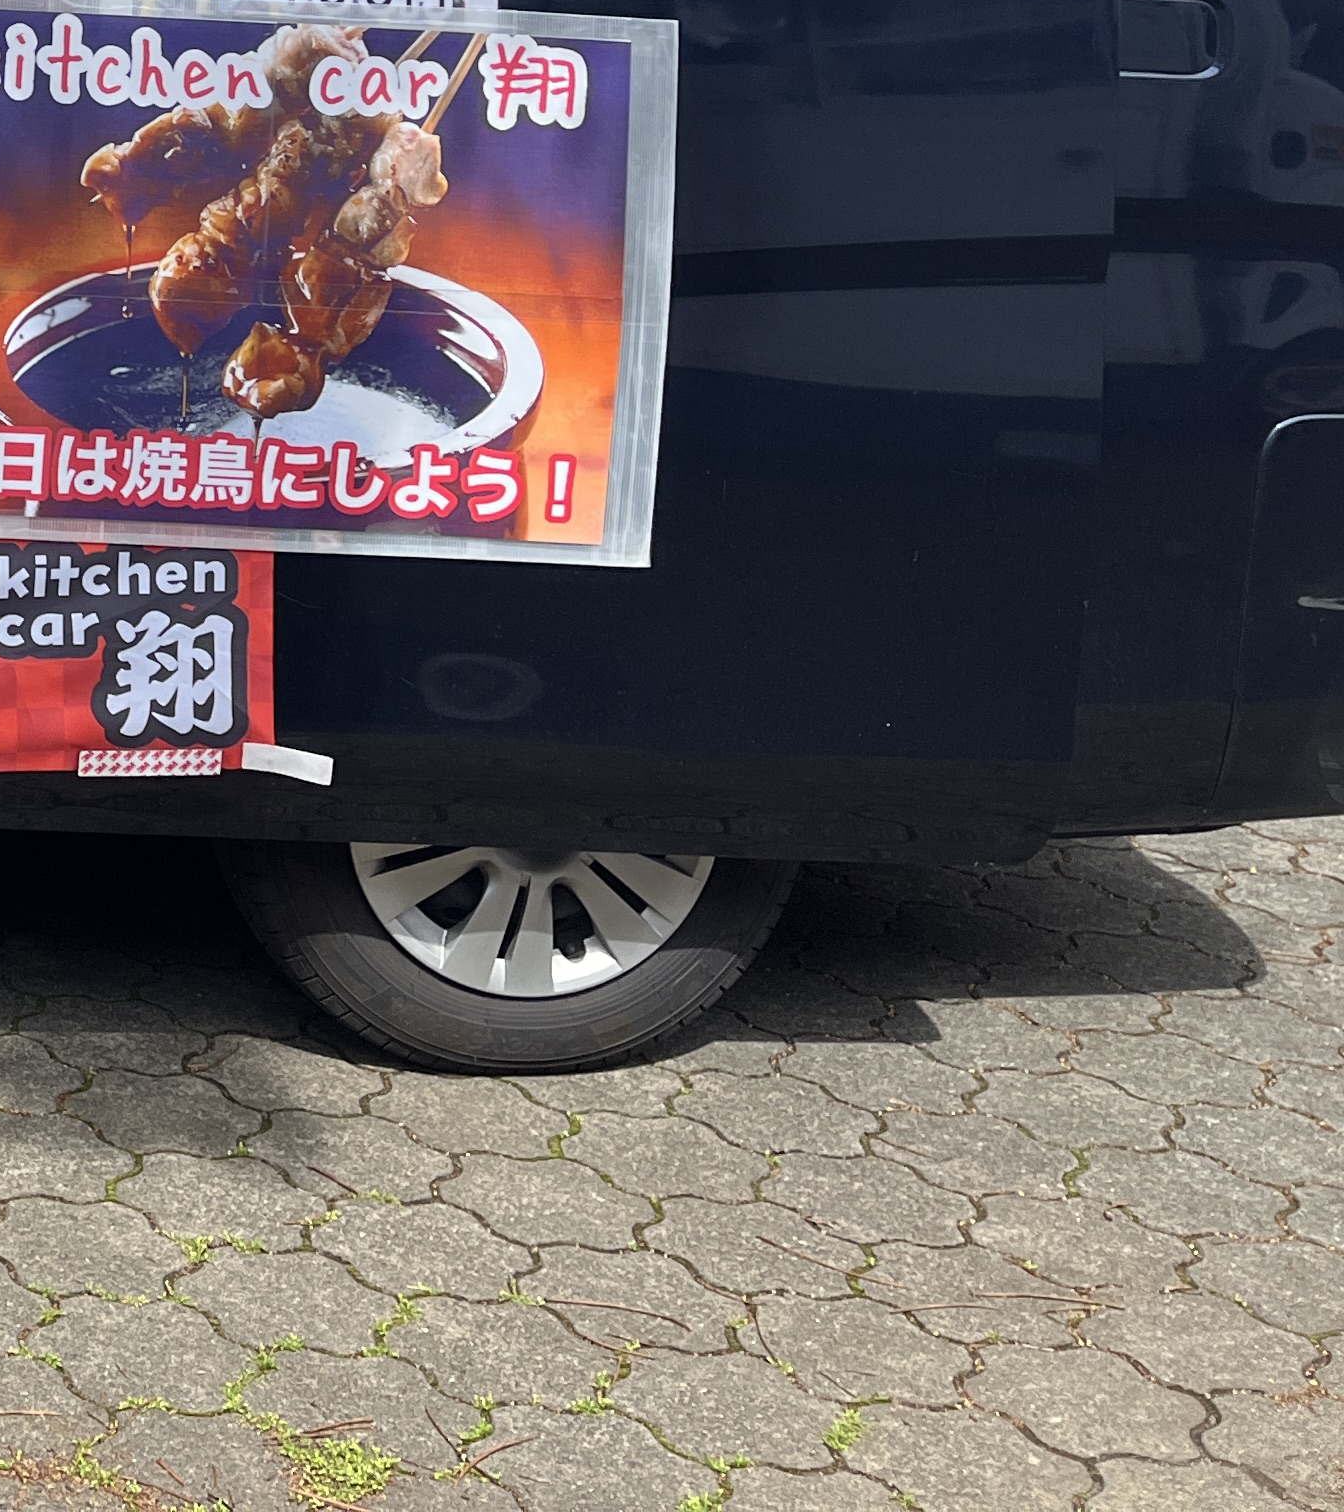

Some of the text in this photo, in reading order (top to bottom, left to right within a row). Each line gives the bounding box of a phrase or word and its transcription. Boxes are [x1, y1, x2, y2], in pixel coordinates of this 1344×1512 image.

[314, 62, 443, 114] car
[486, 39, 583, 126] 翔
[106, 609, 236, 738] 翔
